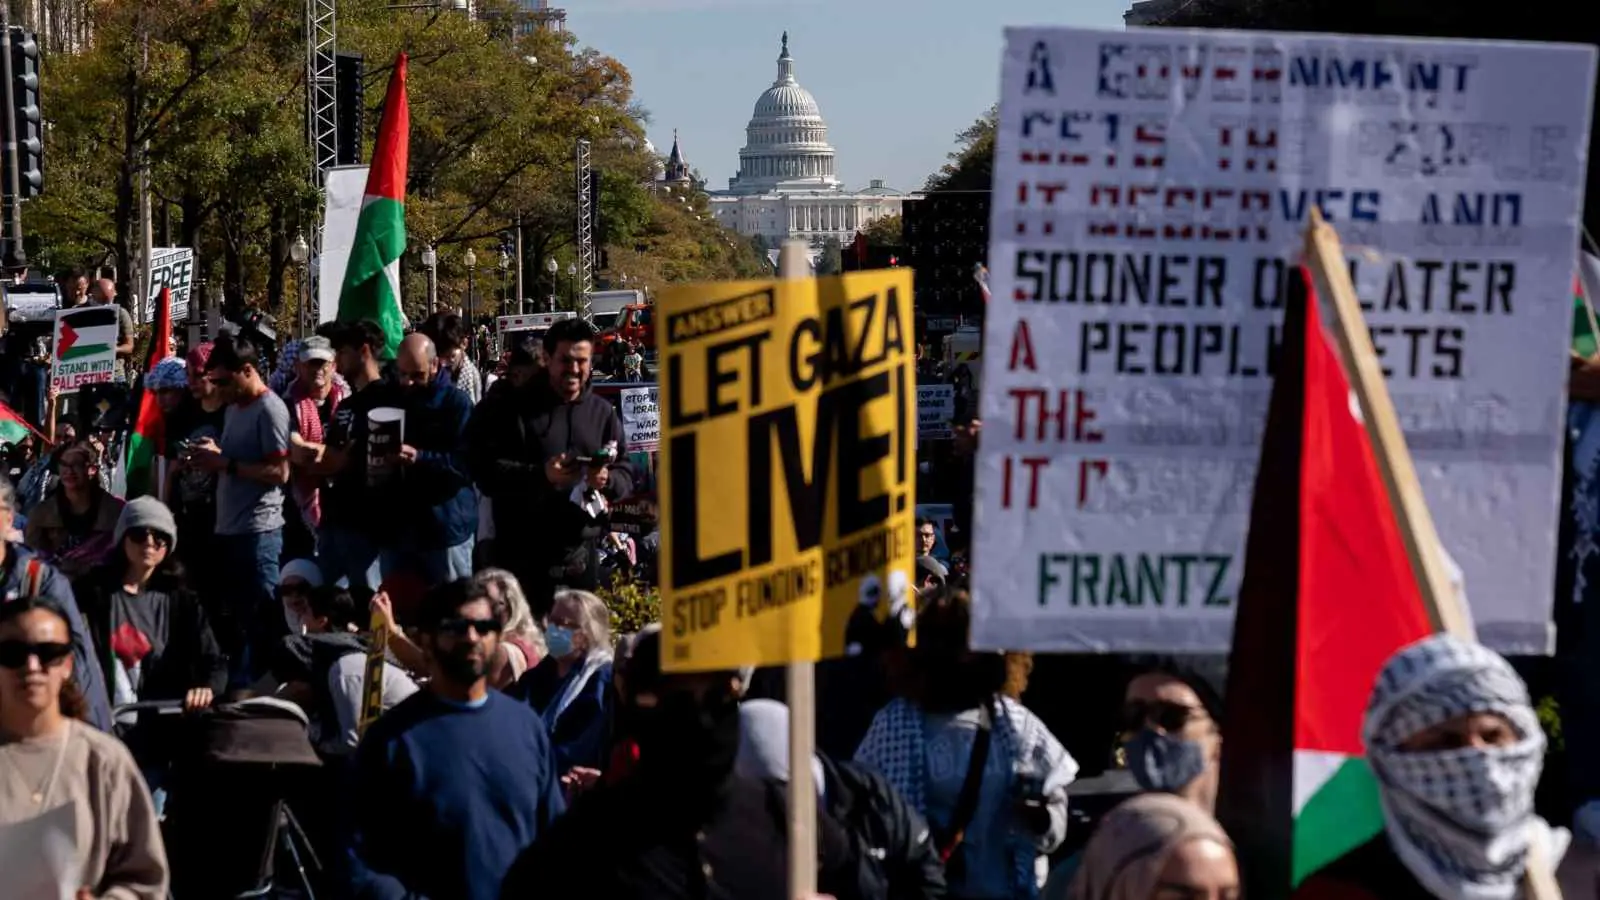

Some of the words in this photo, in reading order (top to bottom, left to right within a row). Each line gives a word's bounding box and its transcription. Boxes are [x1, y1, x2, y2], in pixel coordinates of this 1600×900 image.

[1024, 41, 1055, 95] A
[1015, 182, 1066, 234] IT
[1419, 193, 1523, 246] AND
[148, 260, 191, 297] FREE
[1013, 250, 1227, 308] SOONER
[1253, 257, 1286, 309] O
[1350, 260, 1516, 314] LATER
[671, 292, 772, 339] ANSWER
[58, 361, 88, 376] STAND
[91, 359, 114, 372] WITH
[668, 331, 771, 429] LET
[789, 287, 904, 393] GAZA
[1008, 319, 1037, 372] A
[1368, 327, 1463, 378] ETS
[52, 371, 113, 391] PALESTINE
[625, 394, 649, 402] STOP
[637, 420, 657, 429] WAR
[1007, 389, 1104, 442] THE
[670, 362, 906, 589] LIVE!
[1002, 456, 1050, 509] IT
[1037, 553, 1233, 606] FRANTZ
[672, 587, 726, 637] STOP
